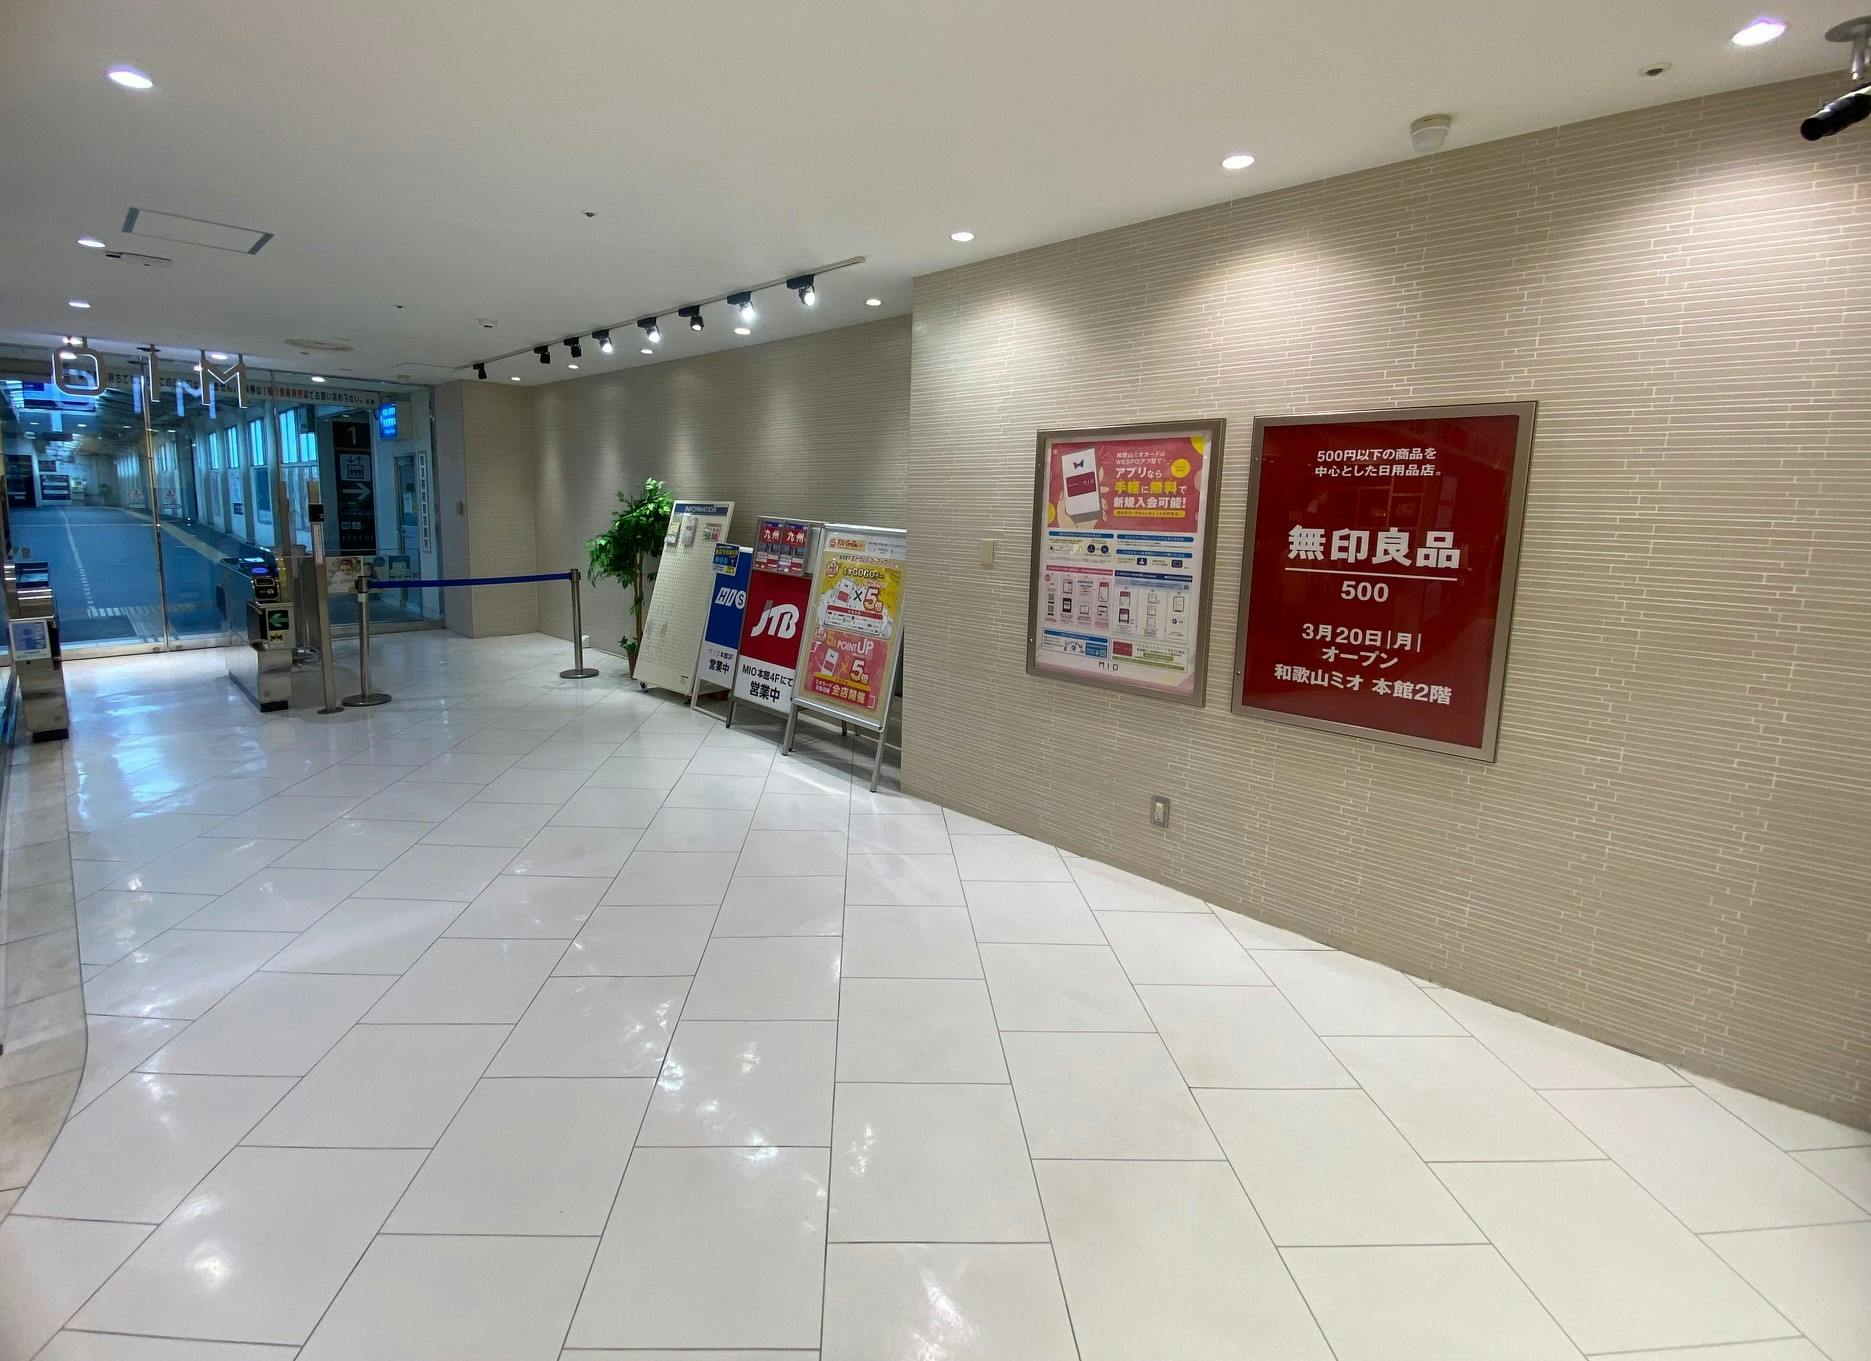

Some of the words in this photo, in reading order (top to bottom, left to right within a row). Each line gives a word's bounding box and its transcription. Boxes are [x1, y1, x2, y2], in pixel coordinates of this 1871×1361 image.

[347, 426, 357, 446] 1
[1317, 448, 1437, 462] 500円以下の商品を
[1115, 467, 1163, 479] アプリなら
[1315, 464, 1442, 477] 中心とした日用品店。
[685, 505, 717, 513] INFORMATION
[1113, 496, 1187, 509] 新規入会可能!
[764, 528, 780, 540] 九州
[786, 531, 805, 543] 九州
[1288, 524, 1462, 569] 無印良品
[1341, 581, 1389, 602] 500
[750, 600, 799, 639] JTB
[1098, 660, 1119, 671] MIO
[1321, 646, 1398, 669] オープン
[709, 658, 730, 675] 営業中
[749, 681, 780, 703] 営業中
[1274, 663, 1364, 691] 和歌山ミオ
[1372, 679, 1452, 705] 本館2階
[831, 683, 866, 704] 全店開催
